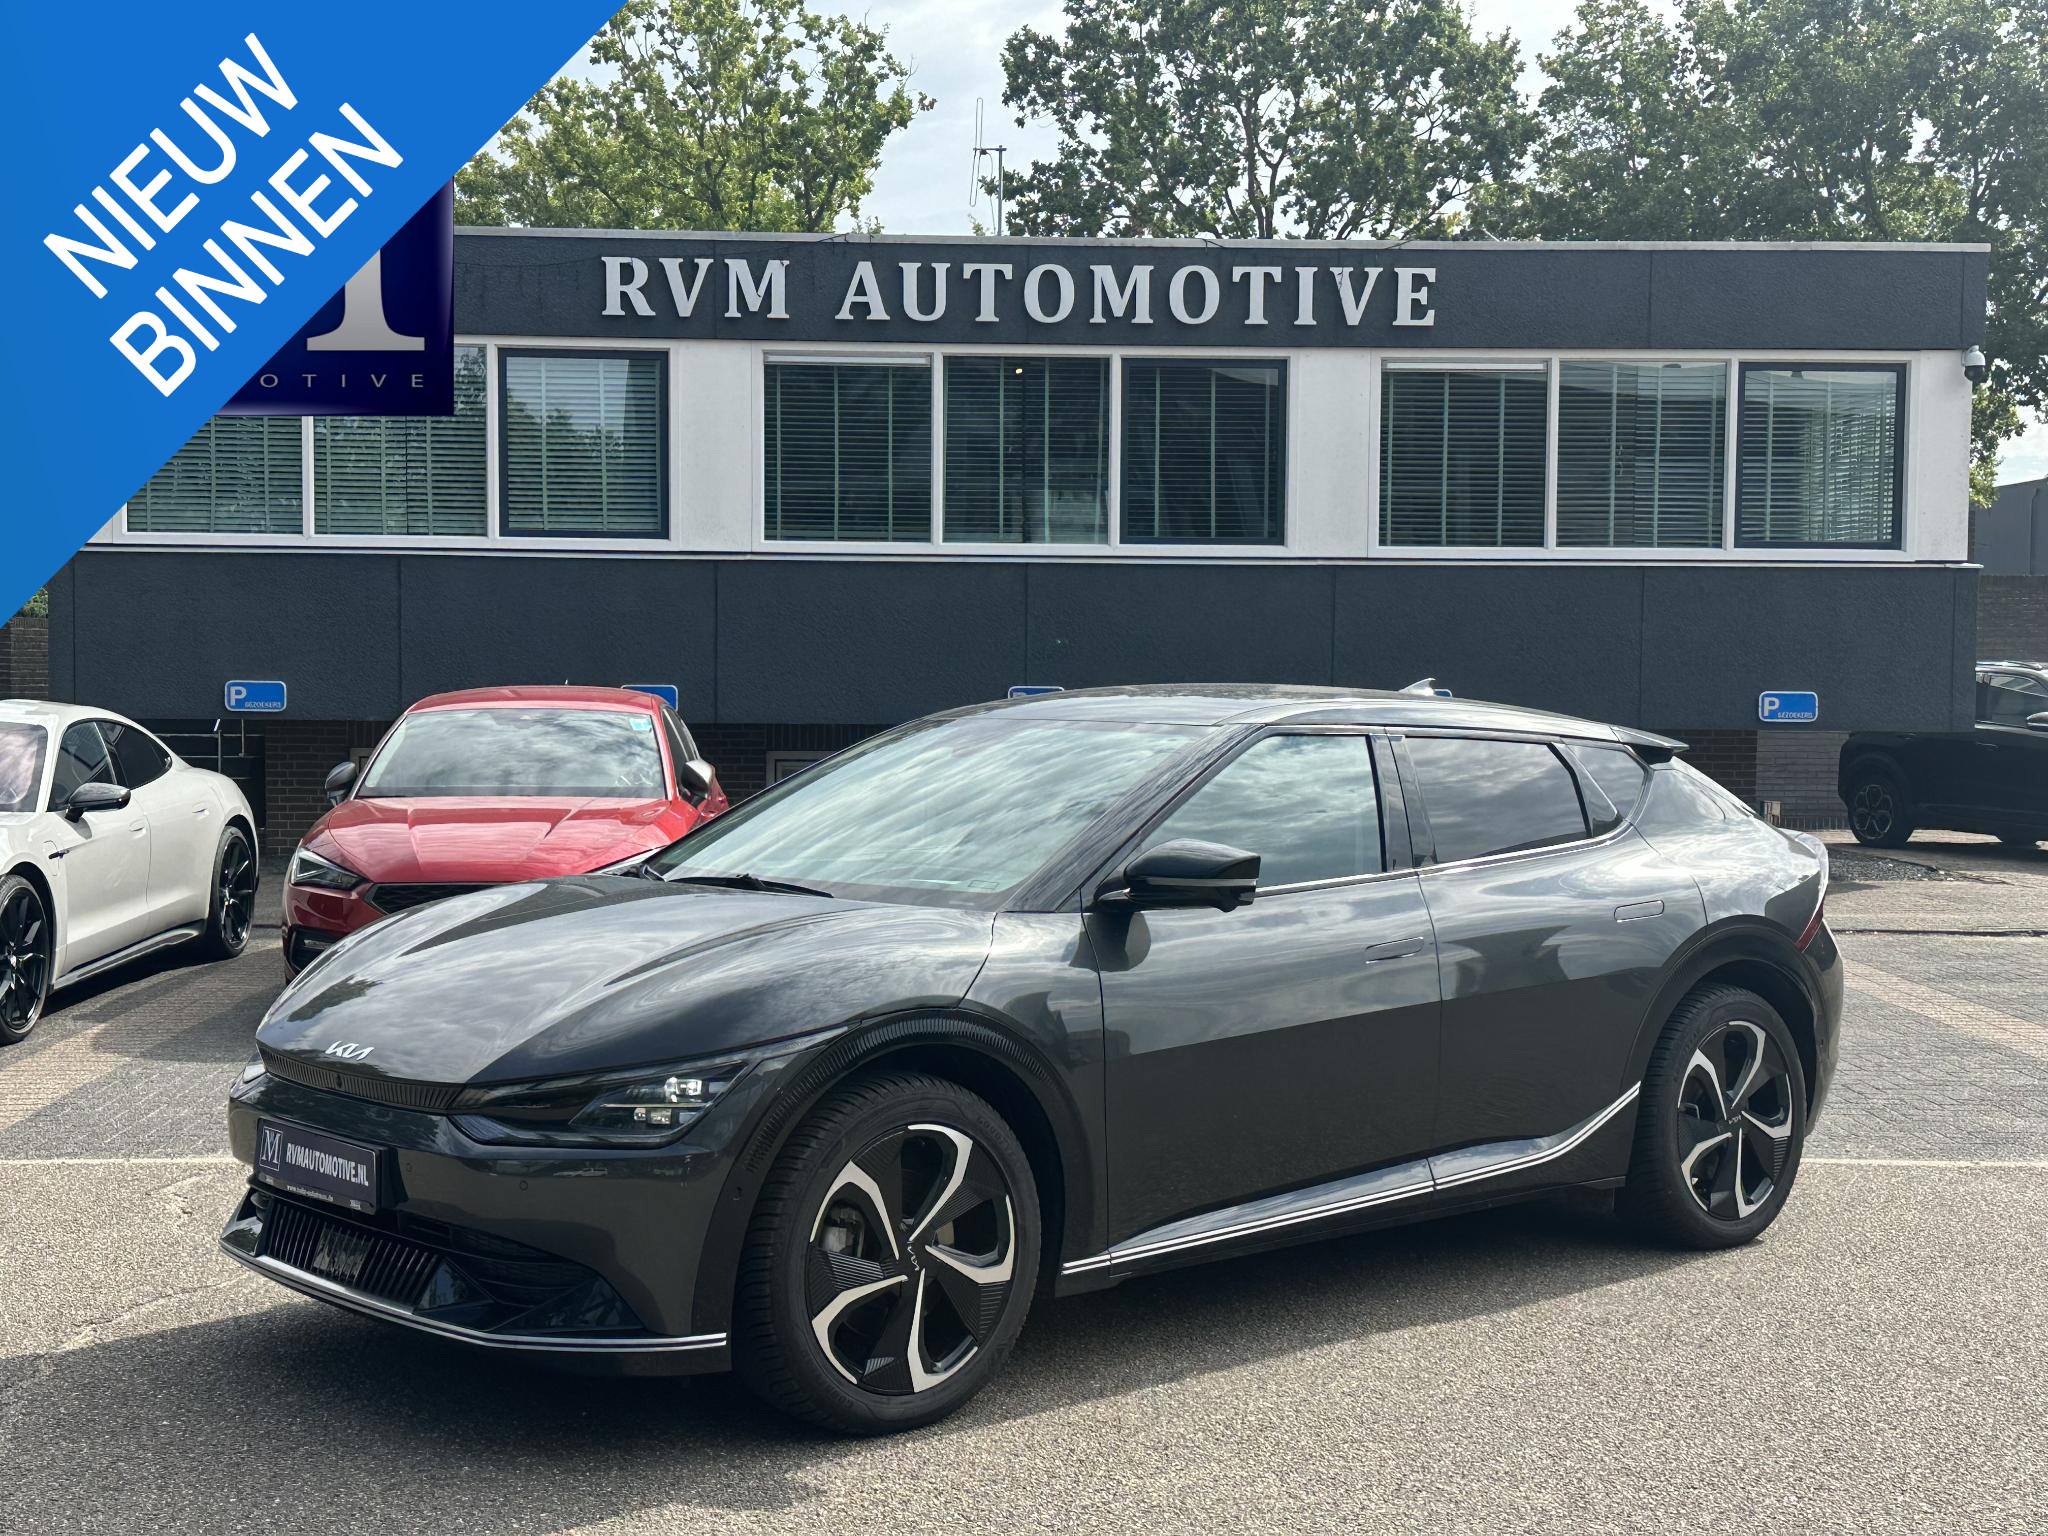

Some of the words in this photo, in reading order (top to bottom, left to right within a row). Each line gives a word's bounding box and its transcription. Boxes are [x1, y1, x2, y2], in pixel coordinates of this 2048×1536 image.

[601, 256, 790, 319] RVM
[834, 261, 1438, 327] AUTOMOTIVE
[230, 686, 246, 706] P
[1763, 697, 1779, 716] P
[286, 1143, 368, 1186] RVMAUTOMOTIVE.NL
